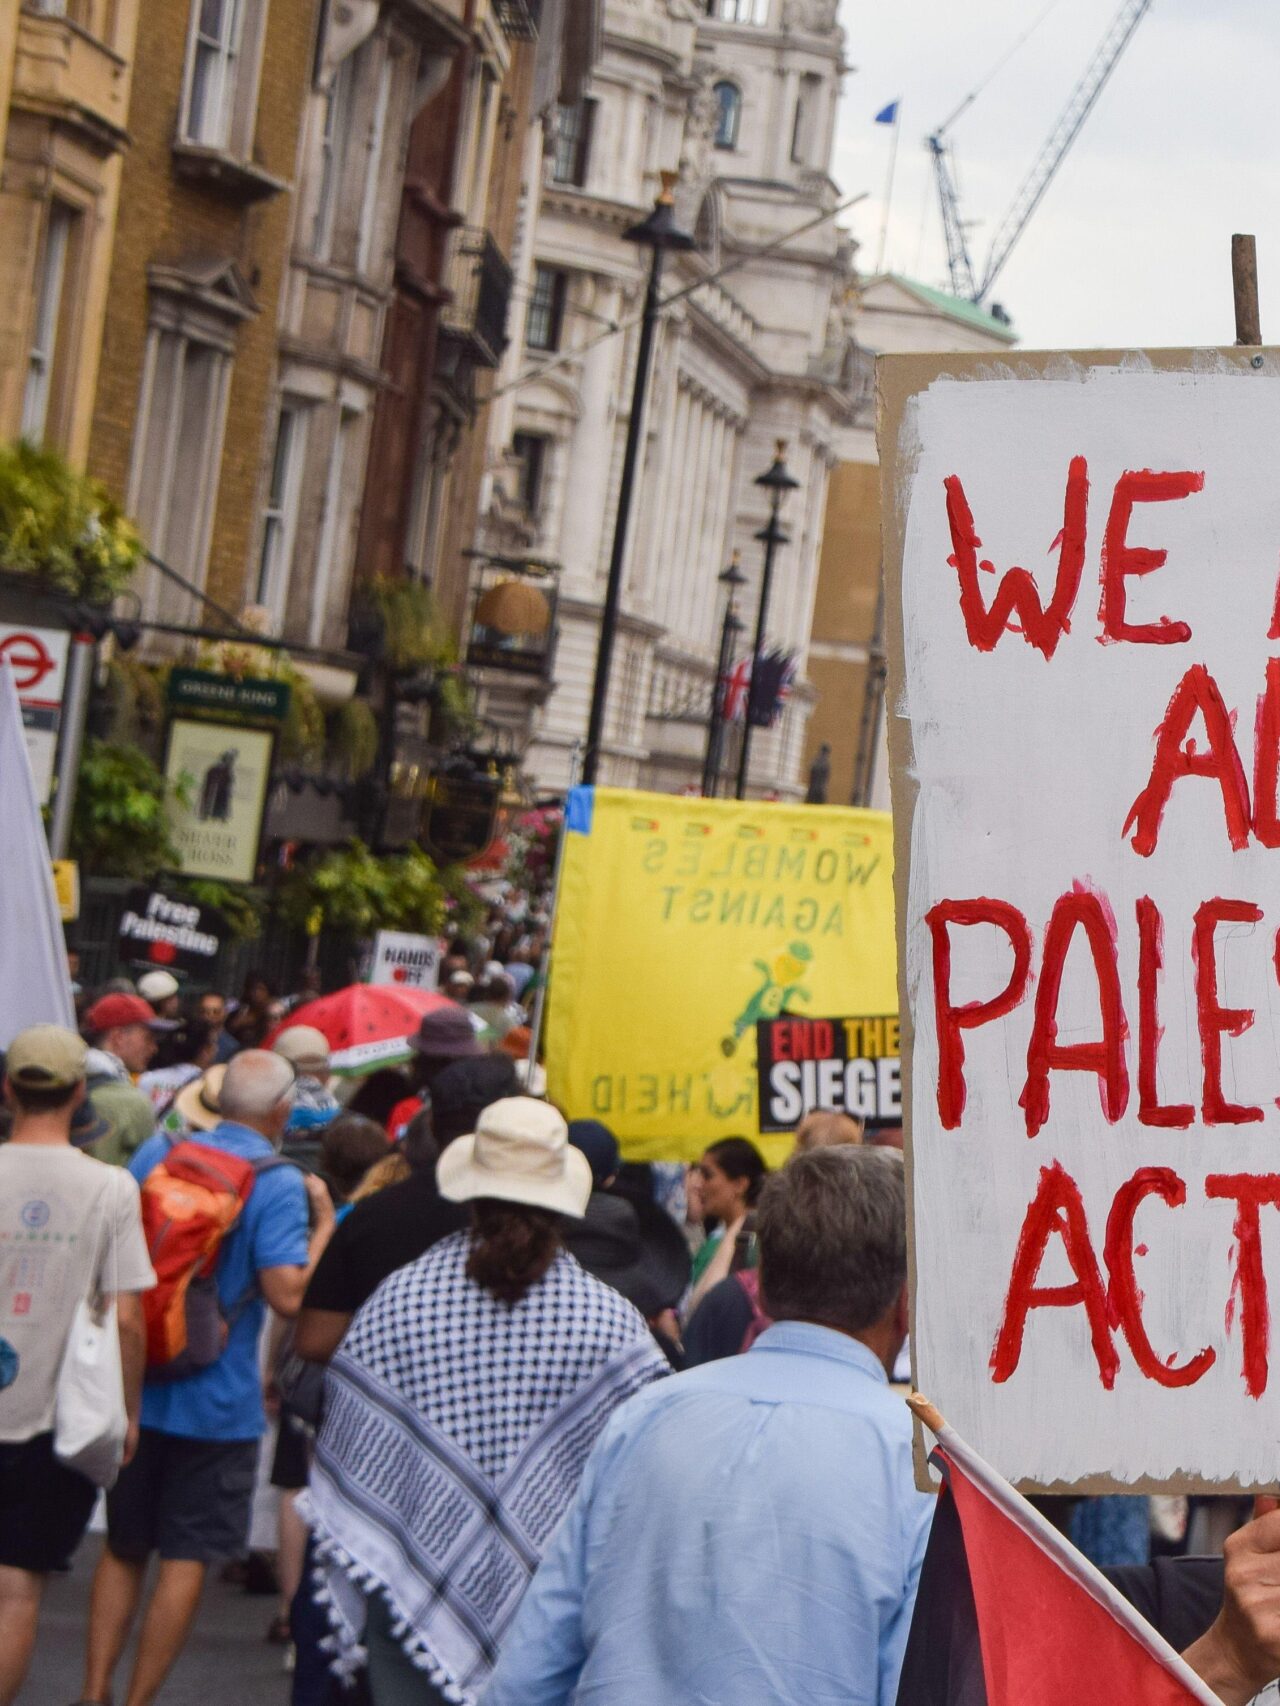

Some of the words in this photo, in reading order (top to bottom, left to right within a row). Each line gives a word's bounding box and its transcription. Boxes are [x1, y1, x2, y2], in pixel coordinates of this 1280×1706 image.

[945, 456, 1204, 660] WE
[240, 686, 279, 706] KING
[146, 892, 200, 924] Free
[119, 911, 219, 956] Palestine
[384, 948, 435, 968] HANDS
[770, 1019, 835, 1062] END
[843, 1016, 900, 1058] THE
[769, 1057, 902, 1125] SIEGE
